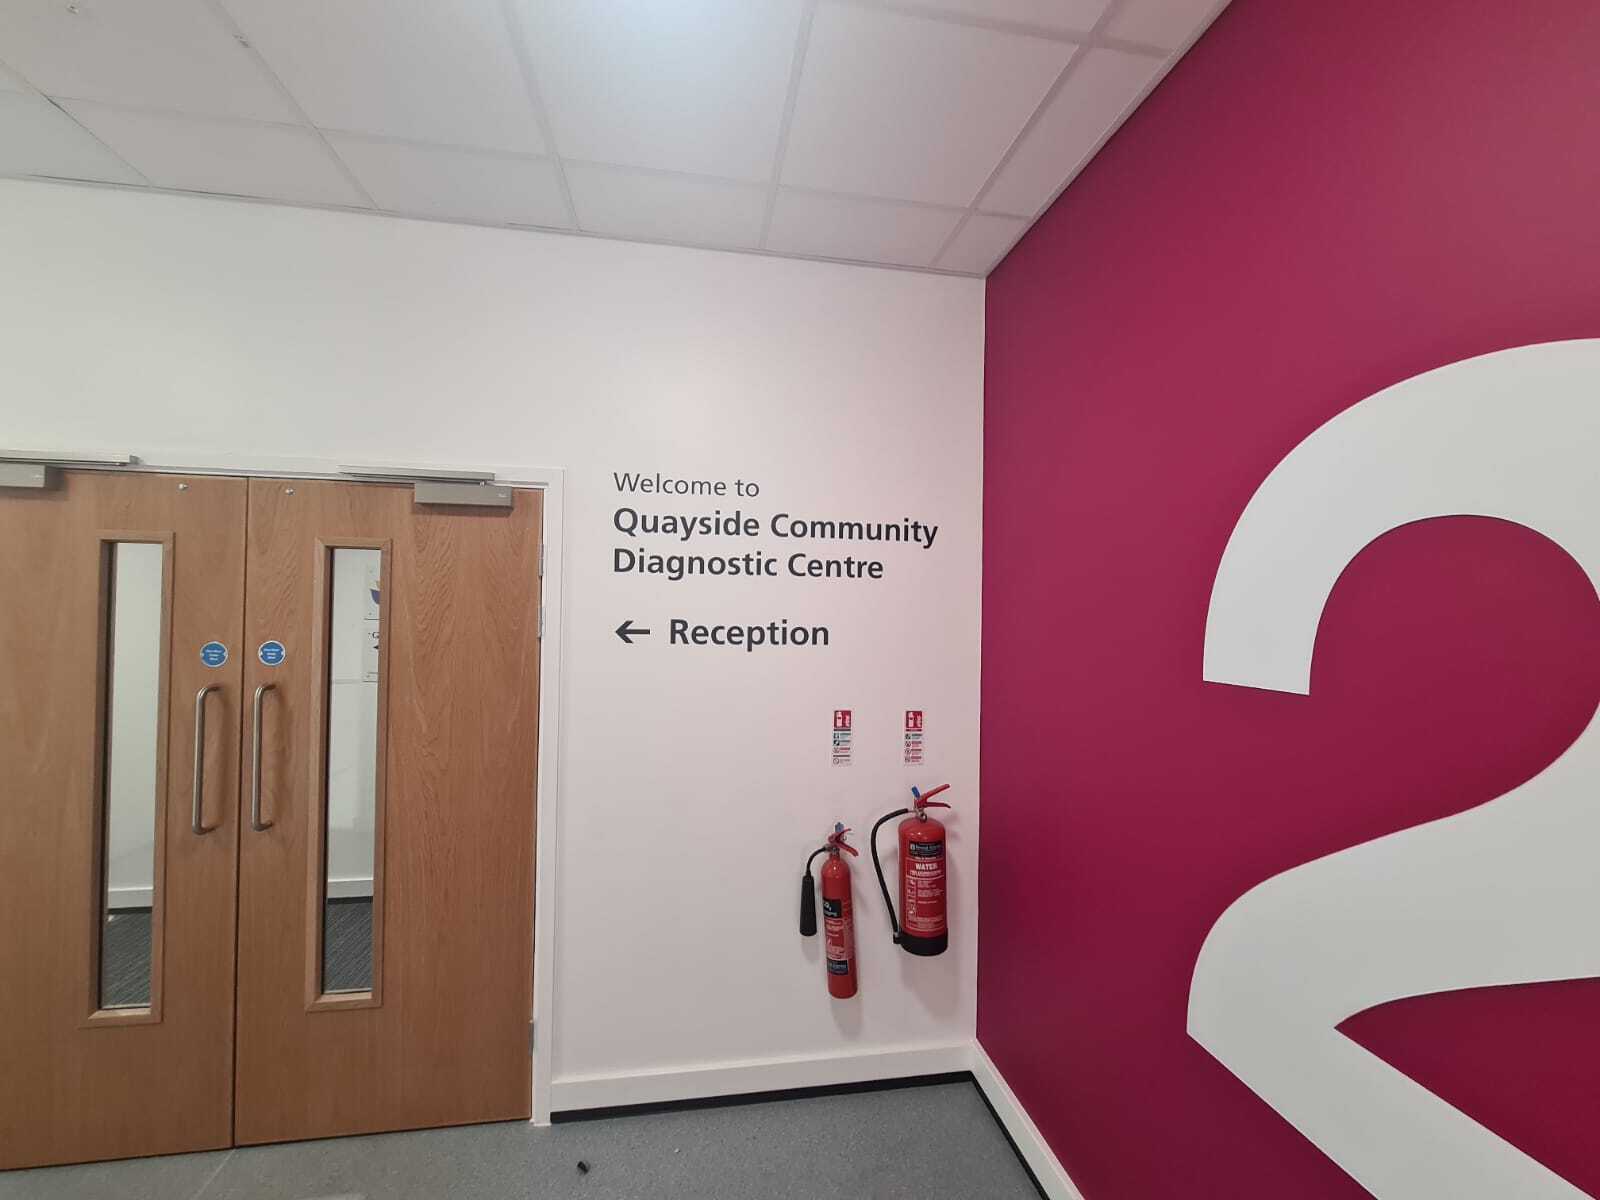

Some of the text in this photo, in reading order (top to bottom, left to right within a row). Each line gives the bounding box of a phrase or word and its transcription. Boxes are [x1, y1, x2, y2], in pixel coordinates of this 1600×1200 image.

[613, 472, 760, 497] Welcome to
[613, 507, 939, 549] Quayside Community
[613, 547, 884, 581] Diagnostic Centre
[669, 618, 830, 652] Reception
